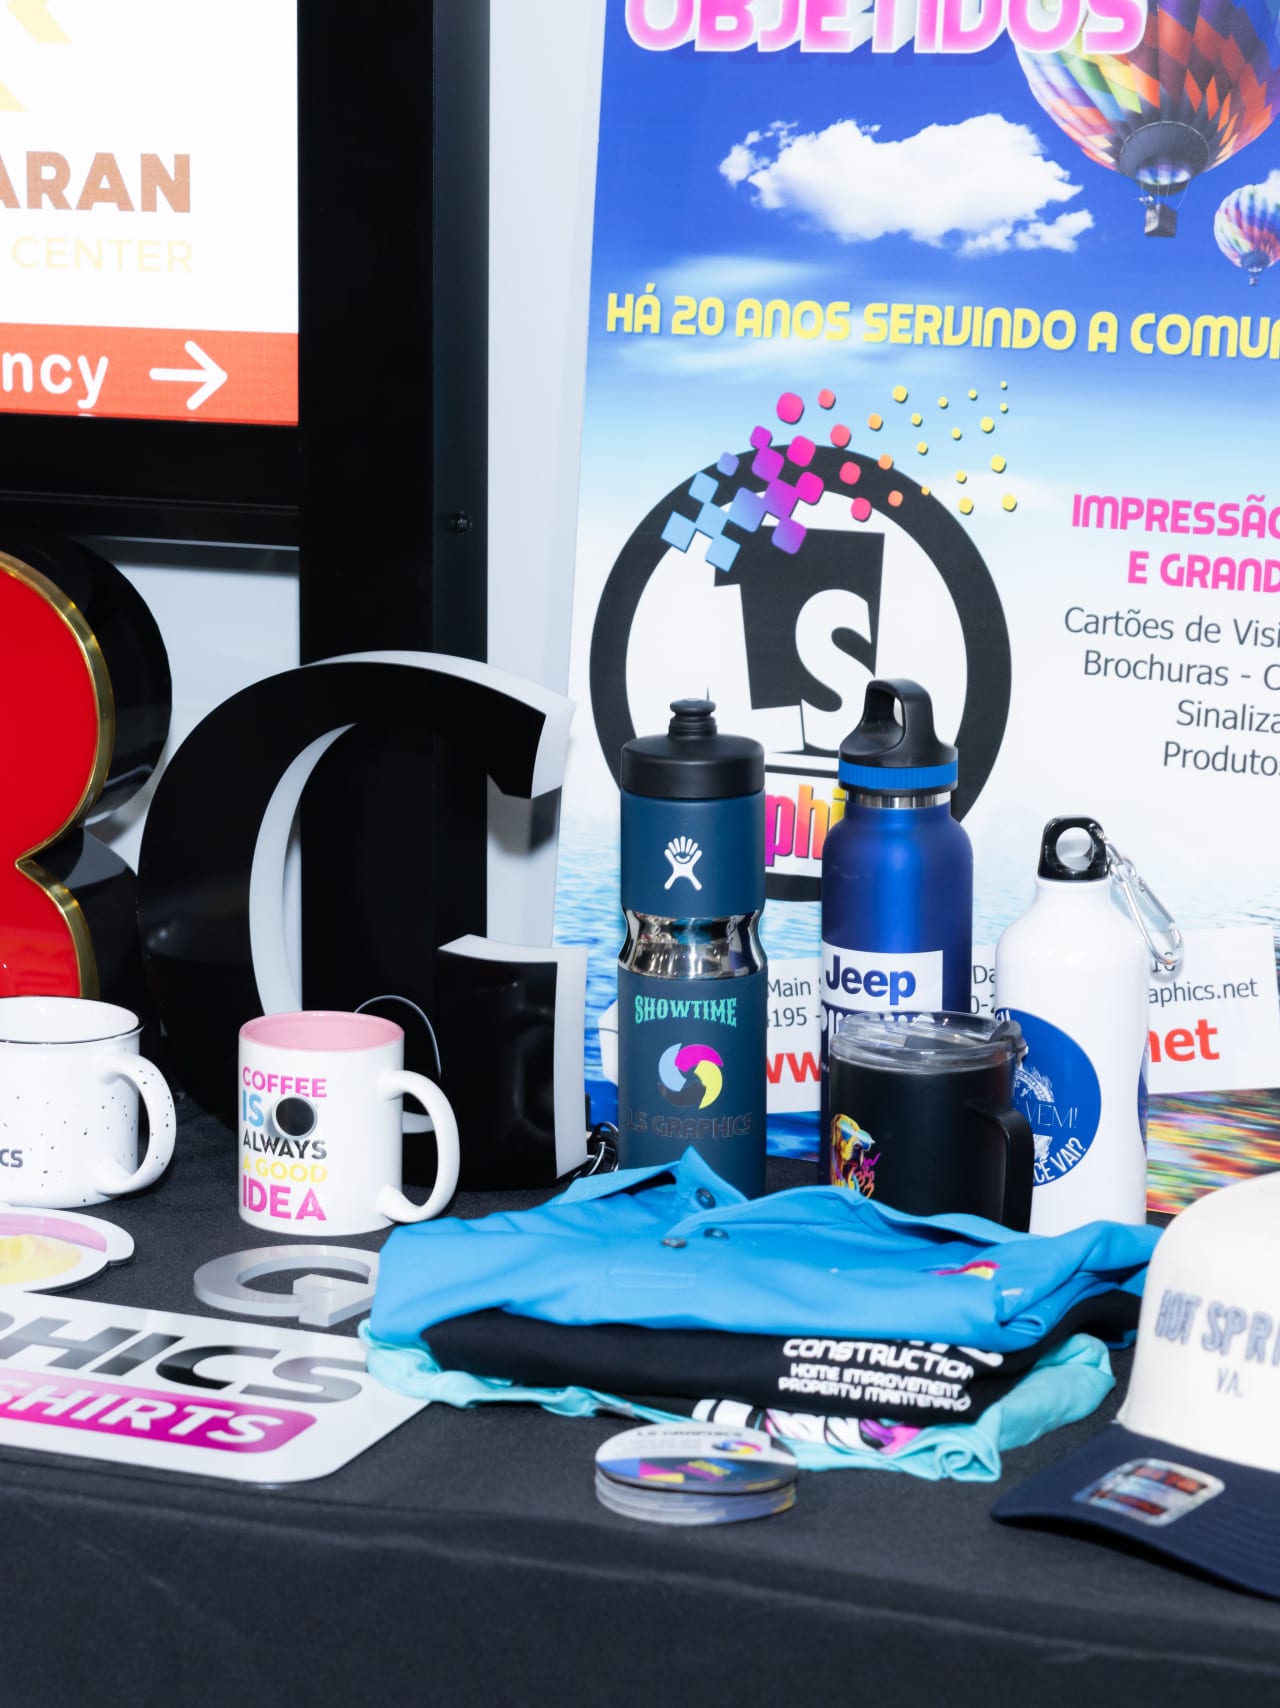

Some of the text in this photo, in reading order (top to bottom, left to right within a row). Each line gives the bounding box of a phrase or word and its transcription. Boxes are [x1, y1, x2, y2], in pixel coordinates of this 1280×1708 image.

[10, 235, 193, 273] CENTER
[606, 283, 661, 333] HÁ
[671, 296, 725, 336] 20
[735, 298, 850, 341] ANOS
[863, 302, 1077, 351] SERVINDO
[1087, 311, 1118, 353] A
[1128, 550, 1149, 584] E
[1064, 607, 1174, 640] Cartões
[1185, 615, 1221, 643] de
[1083, 649, 1229, 687] Brochuras
[1163, 740, 1280, 777] Produto
[825, 955, 917, 1006] Jeep
[1148, 978, 1259, 1008] aphics.net
[634, 994, 737, 1028] SHOWTIME
[242, 1066, 327, 1098] COFFEE
[242, 1089, 265, 1128] IS
[627, 1108, 753, 1139] LS GRAPHICS
[243, 1128, 328, 1160] ALWAYS
[1050, 1137, 1087, 1173] VAI?
[255, 1157, 328, 1183] GOOD
[242, 1173, 328, 1221] IDEA
[1154, 1289, 1203, 1346] HOT
[782, 1338, 974, 1381] CONSTRUCTION
[778, 1376, 863, 1400] PROPERTY
[790, 1362, 963, 1399] HOME IMPROVEMENT
